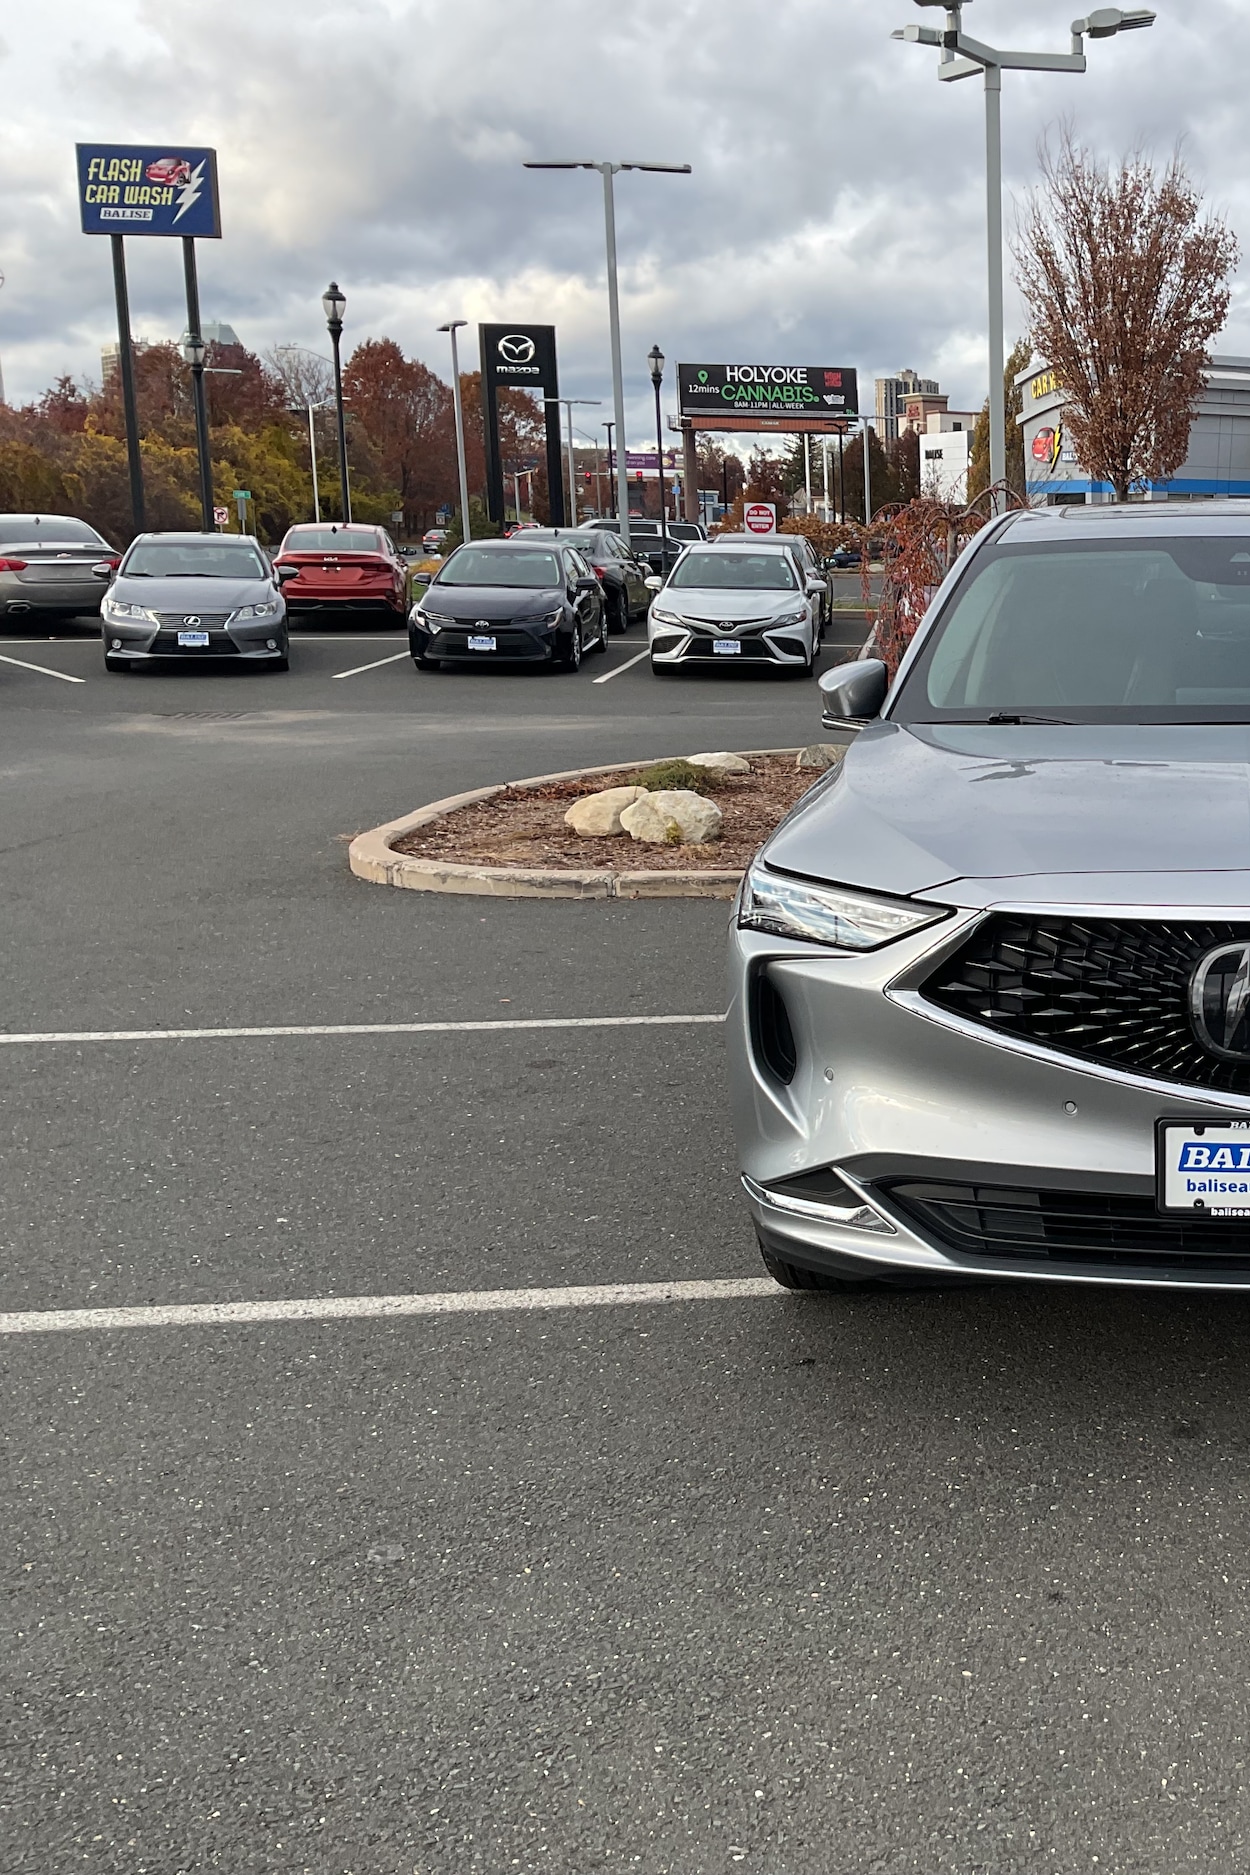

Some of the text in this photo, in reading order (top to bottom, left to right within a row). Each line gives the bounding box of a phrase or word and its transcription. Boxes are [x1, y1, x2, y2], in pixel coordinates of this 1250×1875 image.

[88, 158, 142, 182] FLASH
[85, 184, 173, 205] CAR WASH
[102, 209, 151, 219] BALISE
[496, 366, 540, 375] mazda
[726, 366, 808, 384] HOLYOKE
[688, 384, 720, 394] 12mins
[1031, 374, 1048, 399] CAR
